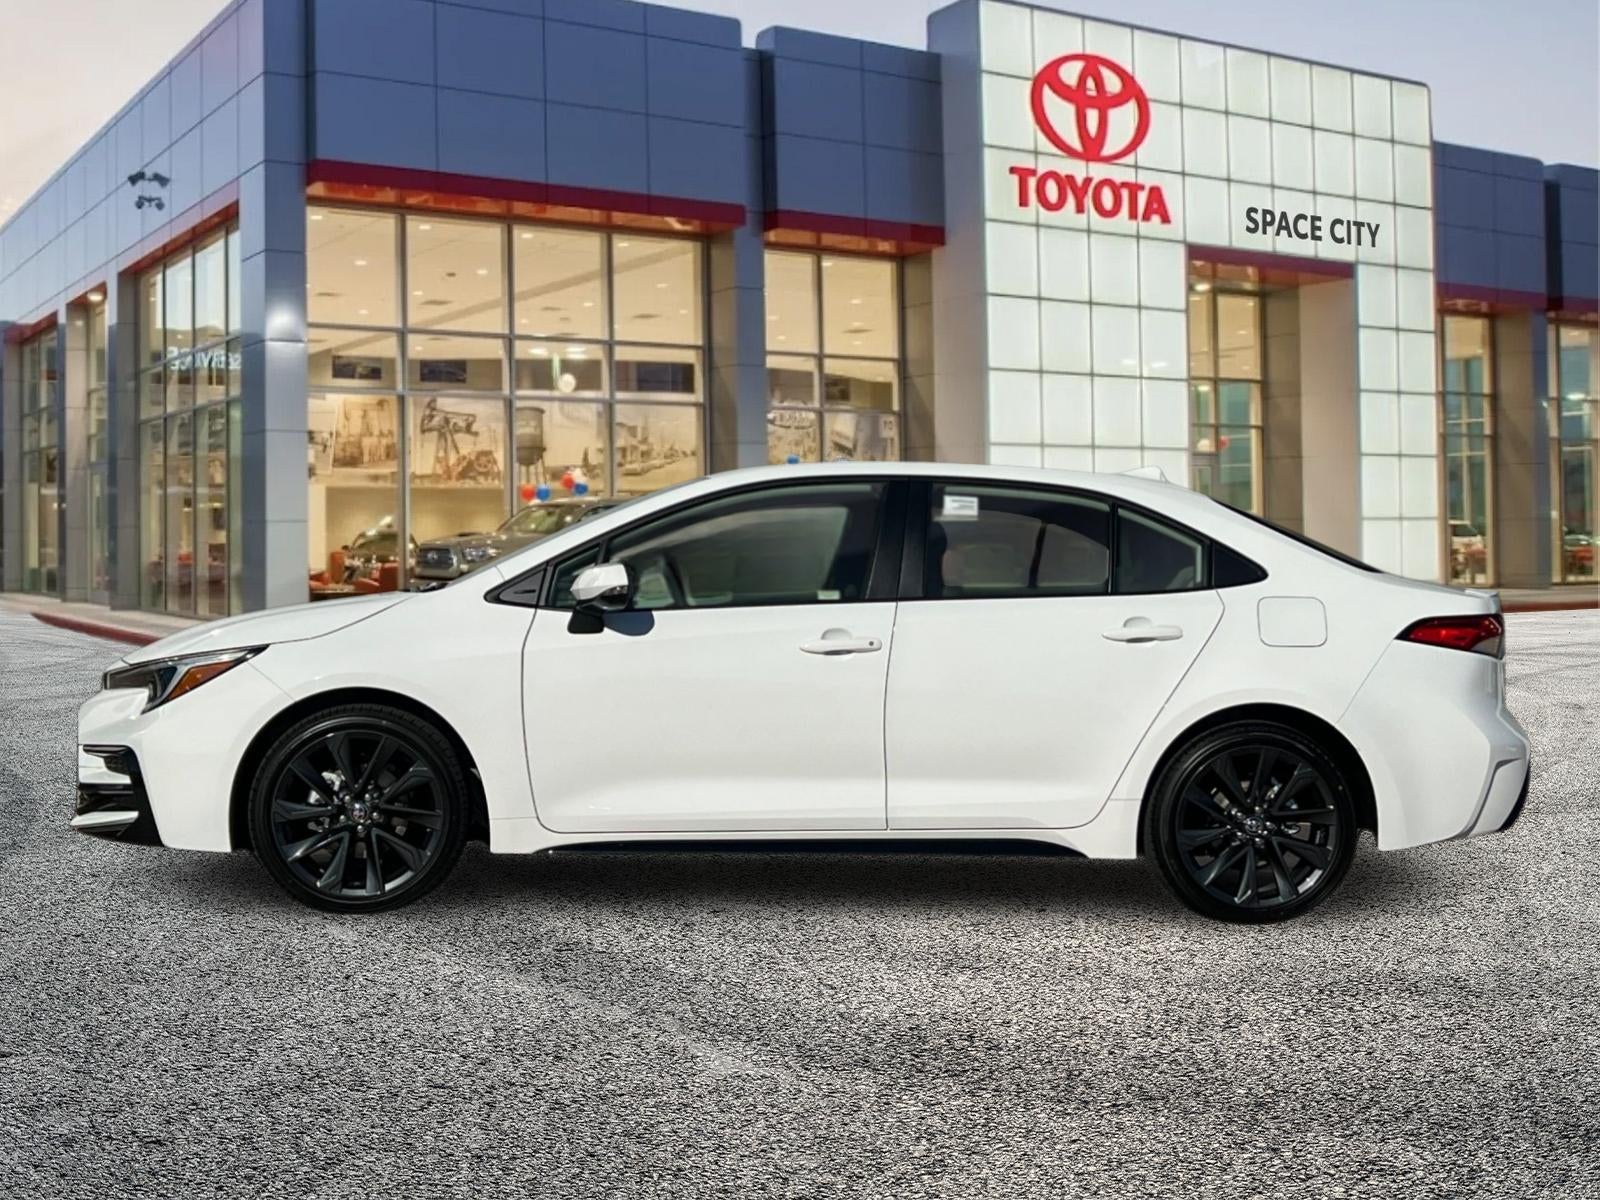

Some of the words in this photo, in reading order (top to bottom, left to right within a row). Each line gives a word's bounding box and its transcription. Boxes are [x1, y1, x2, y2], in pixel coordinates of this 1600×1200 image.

[1009, 166, 1171, 225] TOYOTA
[1245, 206, 1322, 242] SPACE
[1329, 218, 1380, 248] CITY
